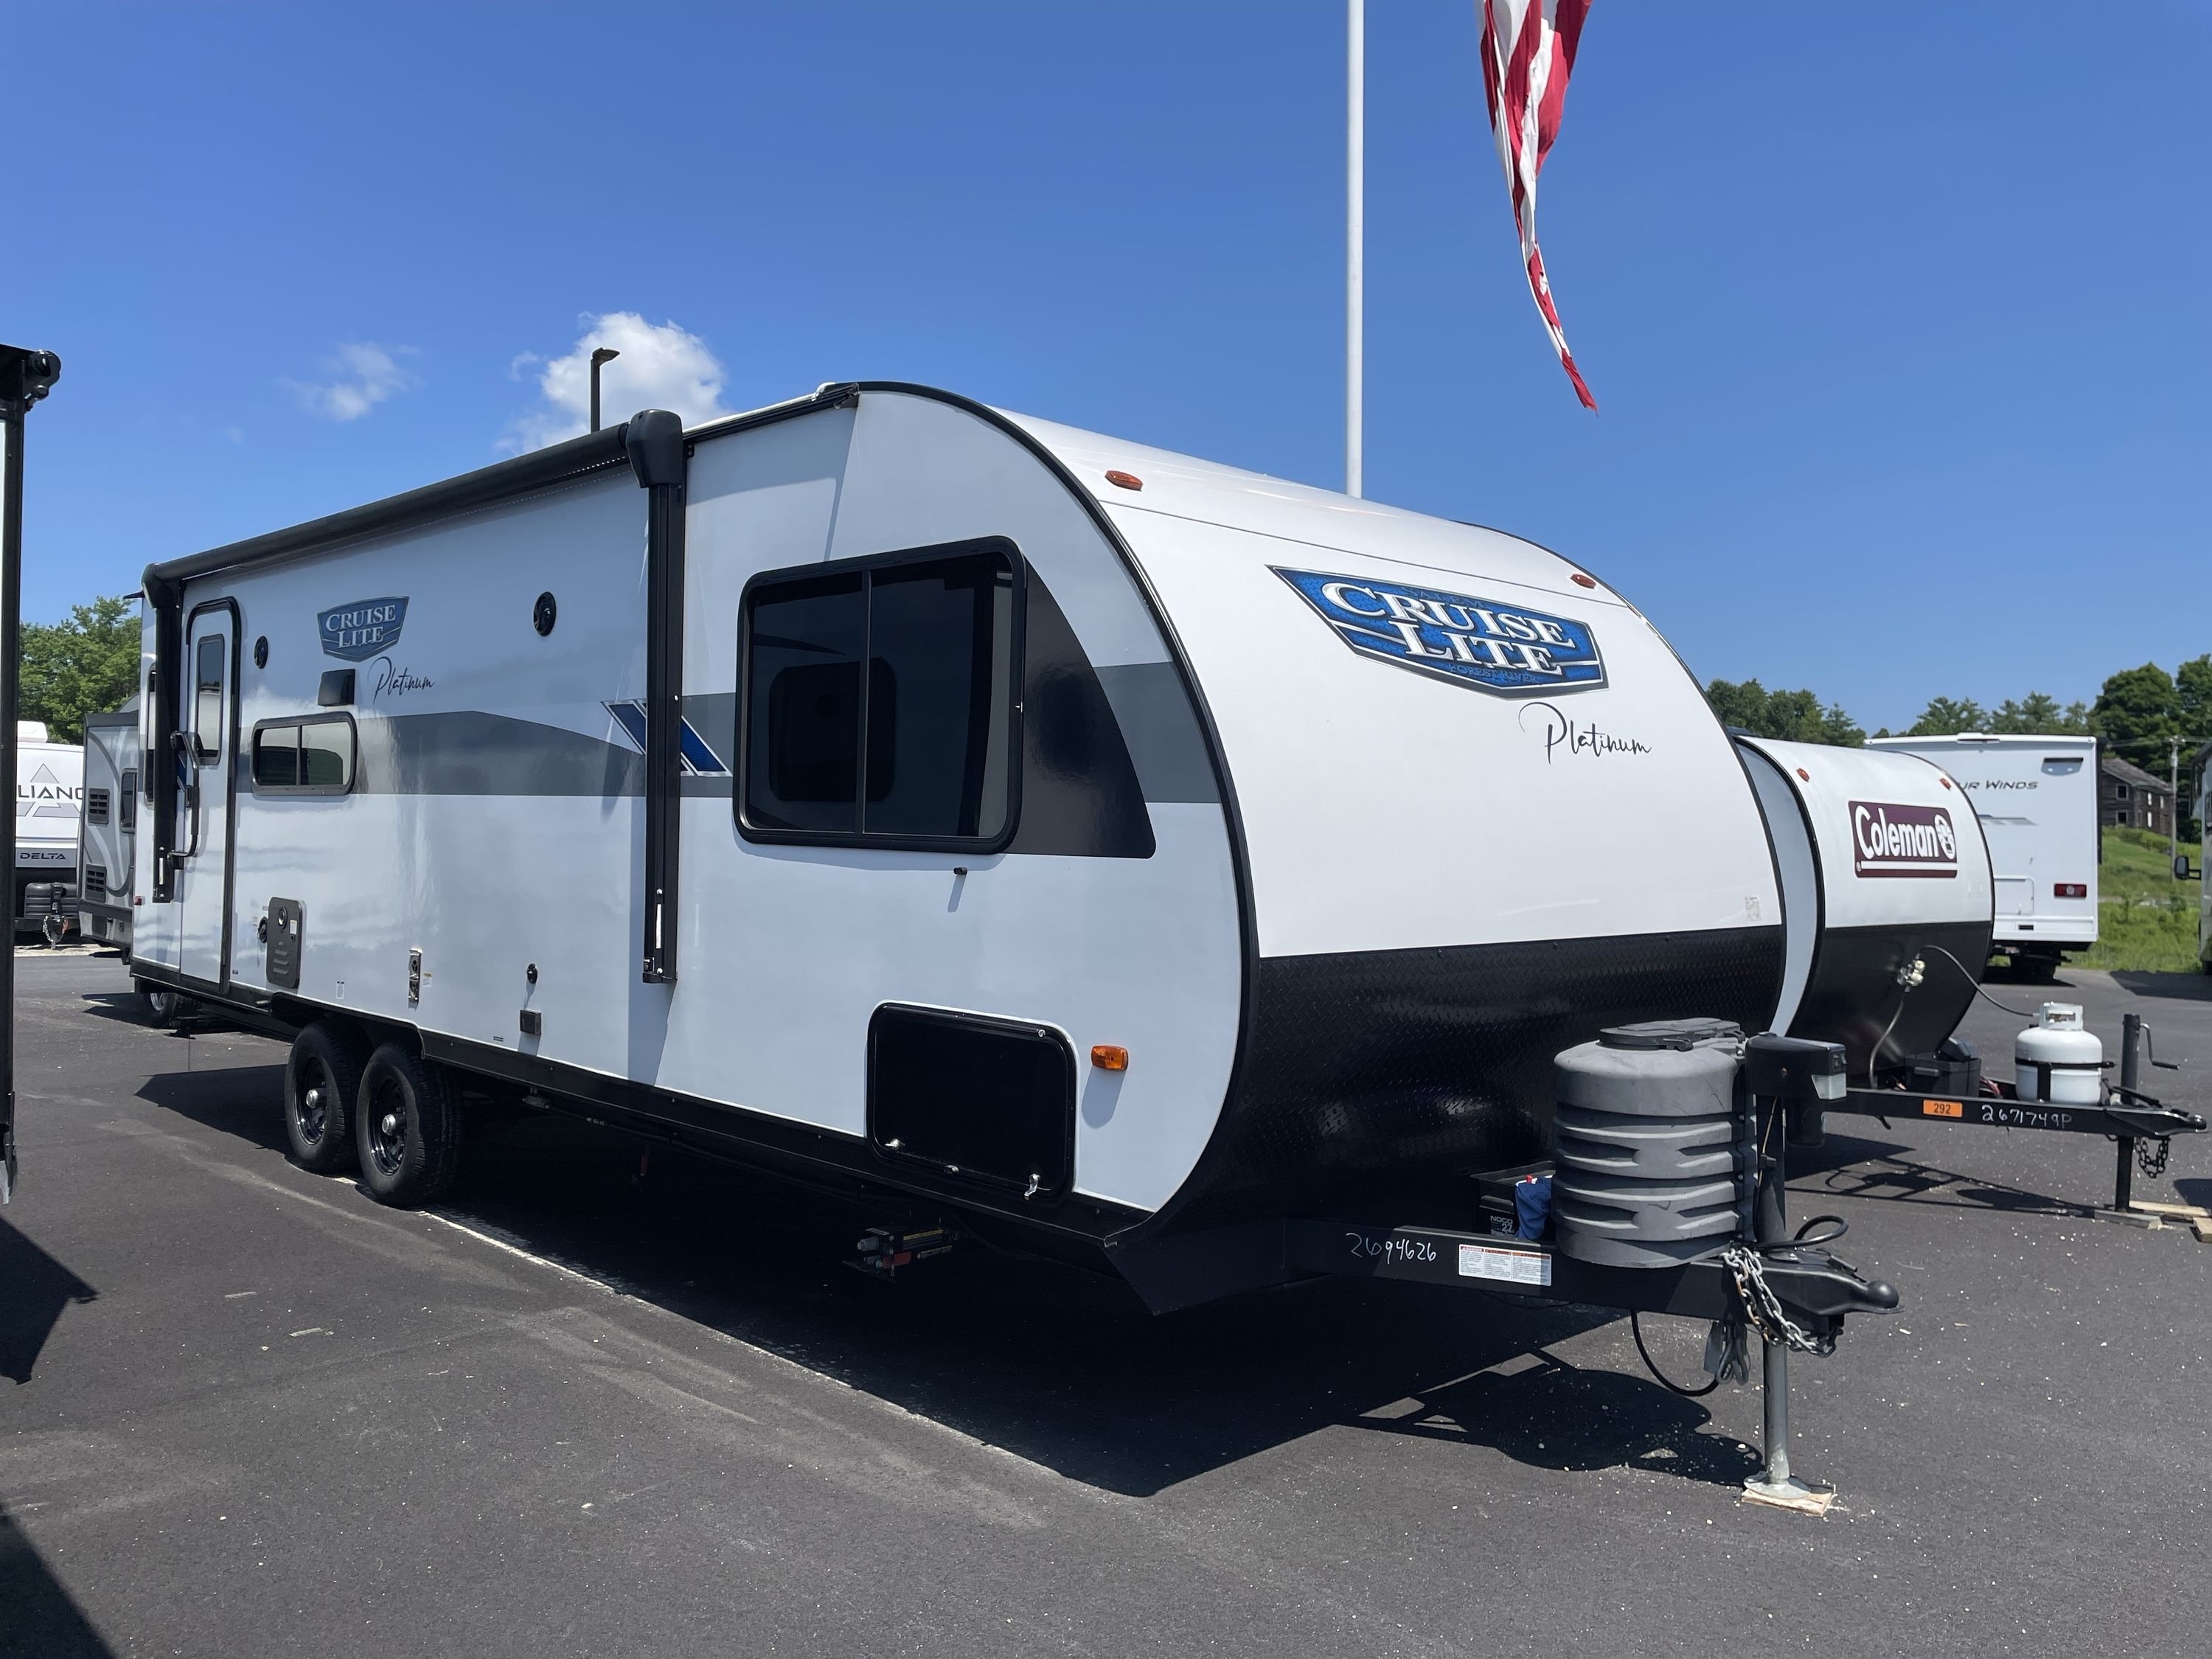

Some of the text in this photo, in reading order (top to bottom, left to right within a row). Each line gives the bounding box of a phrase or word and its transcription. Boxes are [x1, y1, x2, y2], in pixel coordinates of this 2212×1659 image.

[325, 605, 397, 632] CRUISE
[1321, 582, 1576, 650] CRUISE
[337, 626, 384, 649] LITE
[1387, 621, 1562, 676] LITE
[368, 655, 436, 706] Platinum
[1449, 664, 1540, 684] FOREST RIVER
[1517, 702, 1652, 765] Platinum
[1986, 779, 2039, 790] WINDS
[1854, 804, 1940, 860] Coleman
[20, 852, 66, 860] DELTA
[1933, 1102, 1952, 1115] 292
[1346, 1232, 1437, 1265] 2694626
